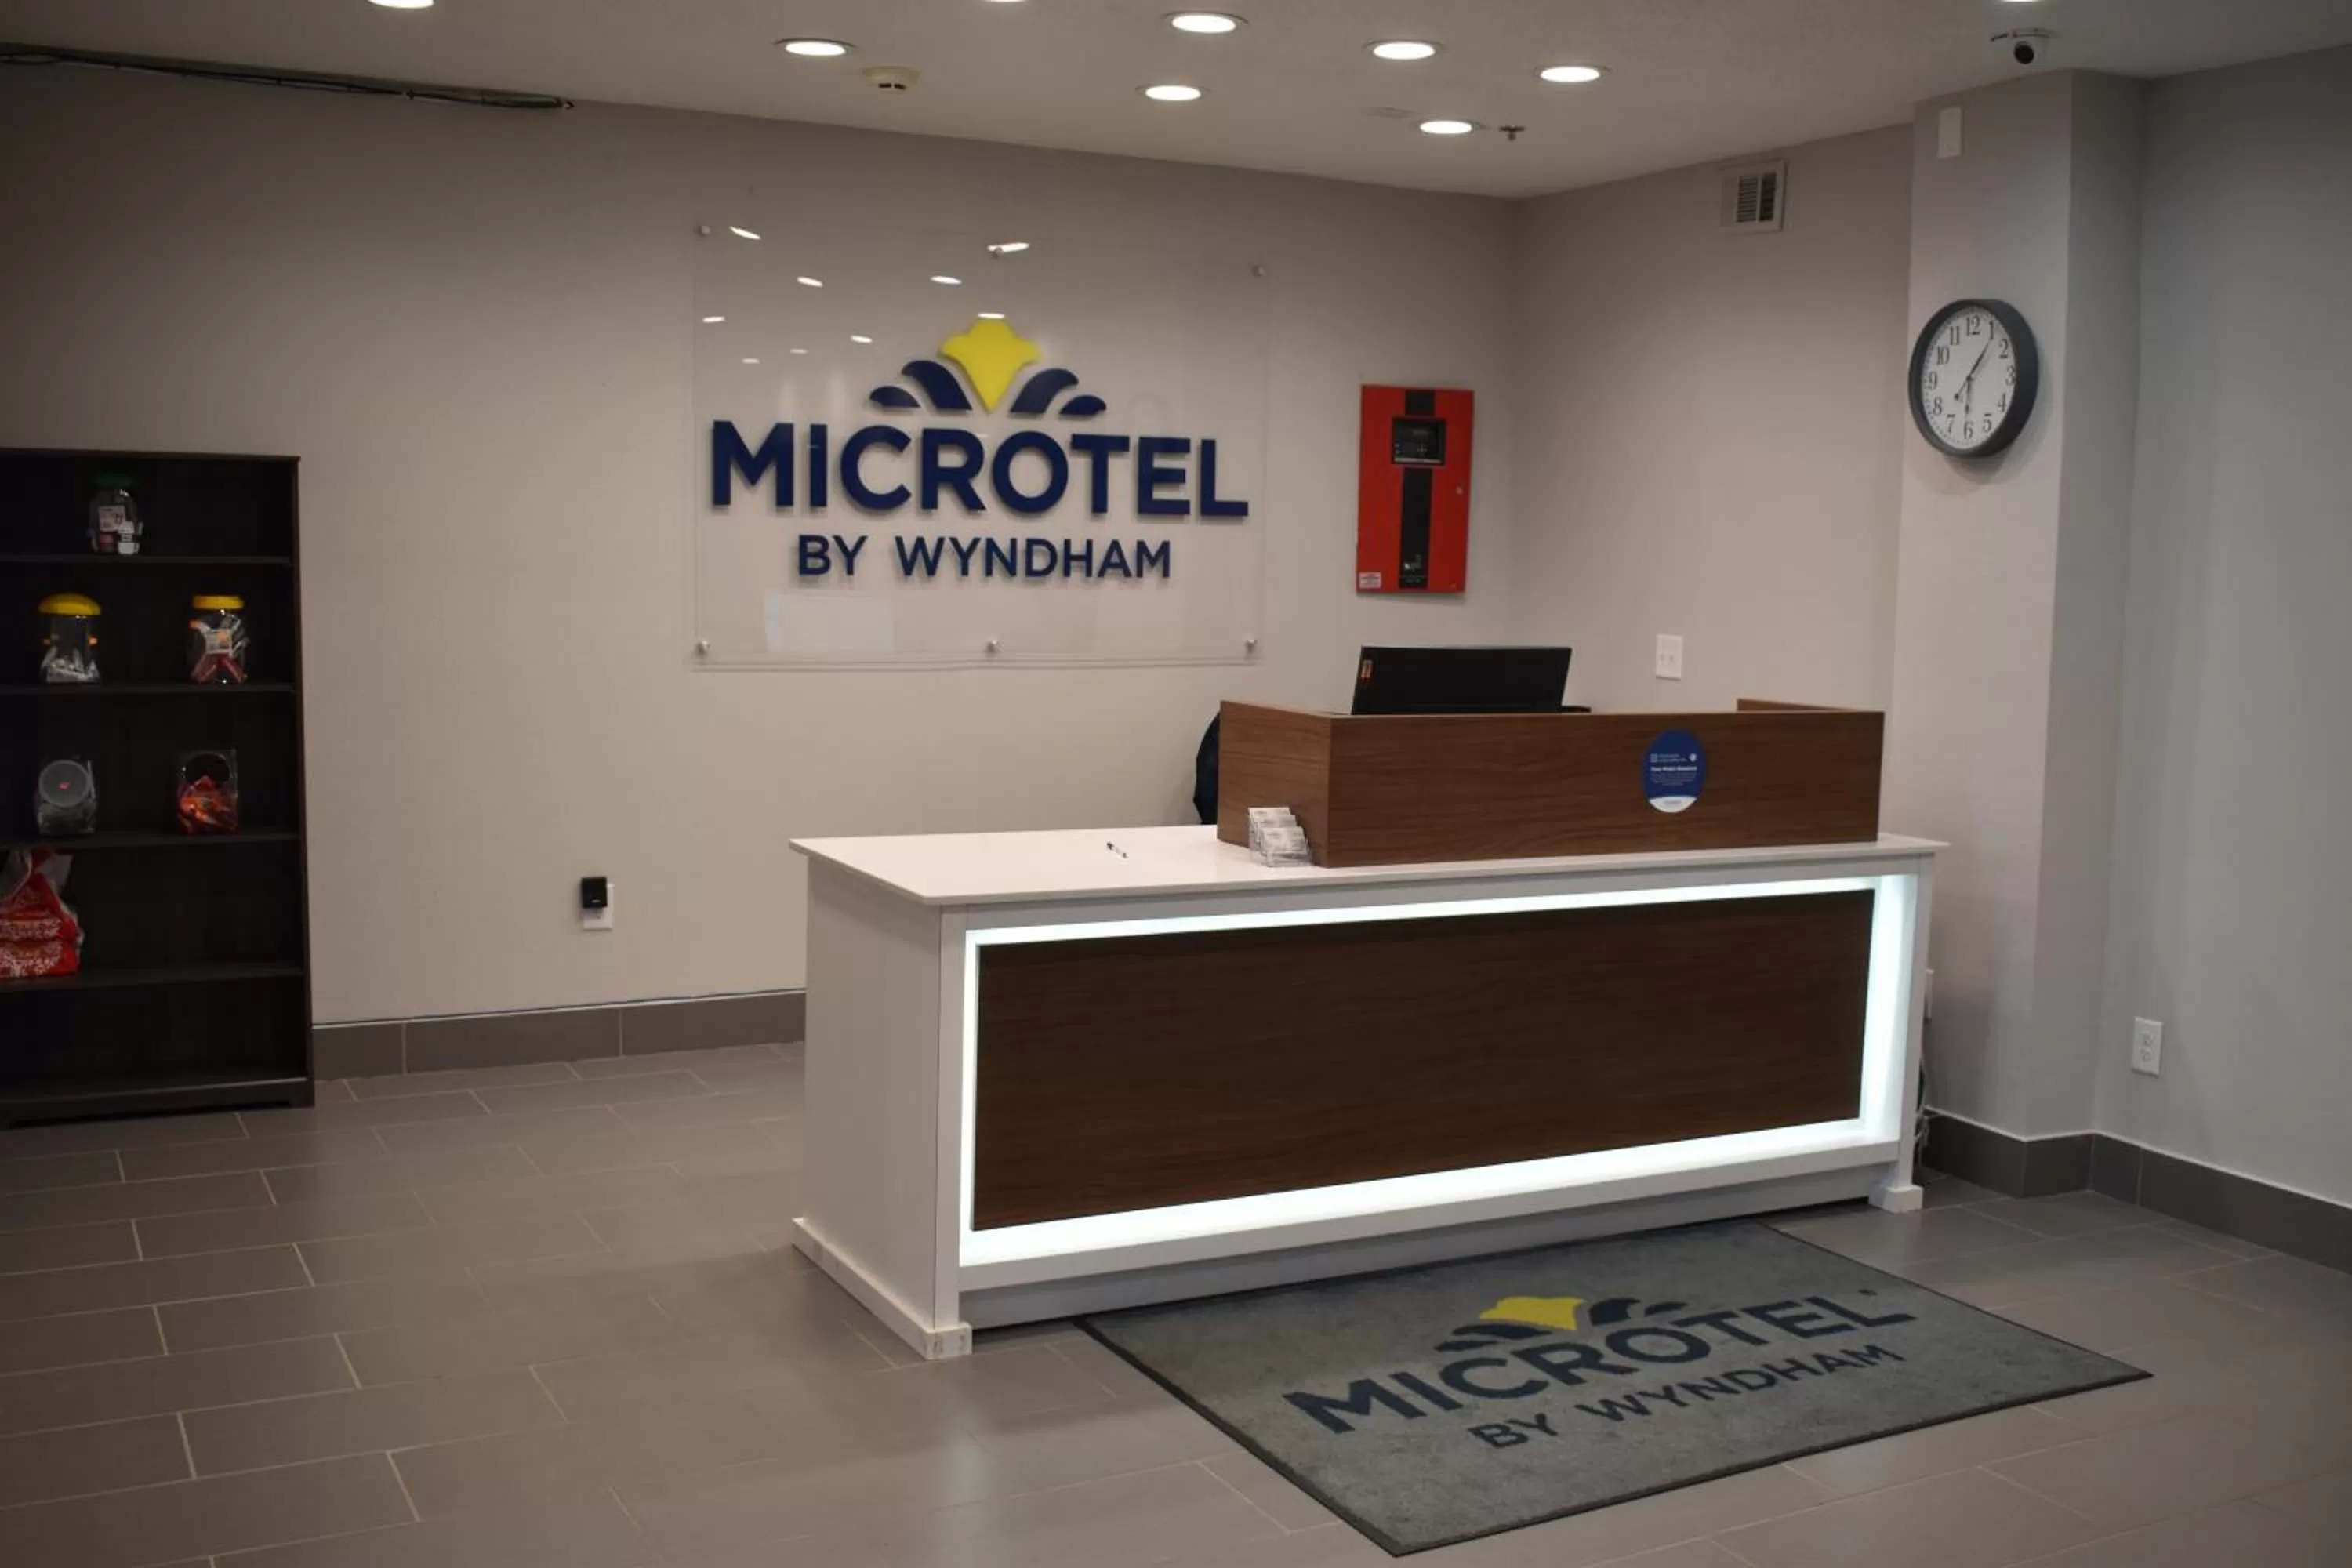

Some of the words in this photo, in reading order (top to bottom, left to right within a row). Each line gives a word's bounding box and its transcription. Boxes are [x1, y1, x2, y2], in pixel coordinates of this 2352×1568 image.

[1950, 325, 1960, 346] 11
[1965, 314, 1980, 336] 12
[1988, 321, 1995, 340] 1
[1936, 345, 1950, 365] 10
[1999, 338, 2009, 359] 2
[1928, 371, 1938, 390] 9
[2005, 365, 2016, 386] 3
[1933, 396, 1943, 416] 8
[1998, 392, 2006, 412] 4
[1947, 413, 1956, 434] 7
[1963, 421, 1973, 440] 6
[1982, 413, 1992, 433] 5
[712, 419, 1249, 517] MICROTEL
[798, 534, 868, 577] BY
[895, 536, 1171, 579] WYNDHAM
[1282, 1295, 1918, 1435] MICROTEL
[1466, 1412, 1559, 1450] BY
[1573, 1343, 1906, 1424] WYNDHAM
